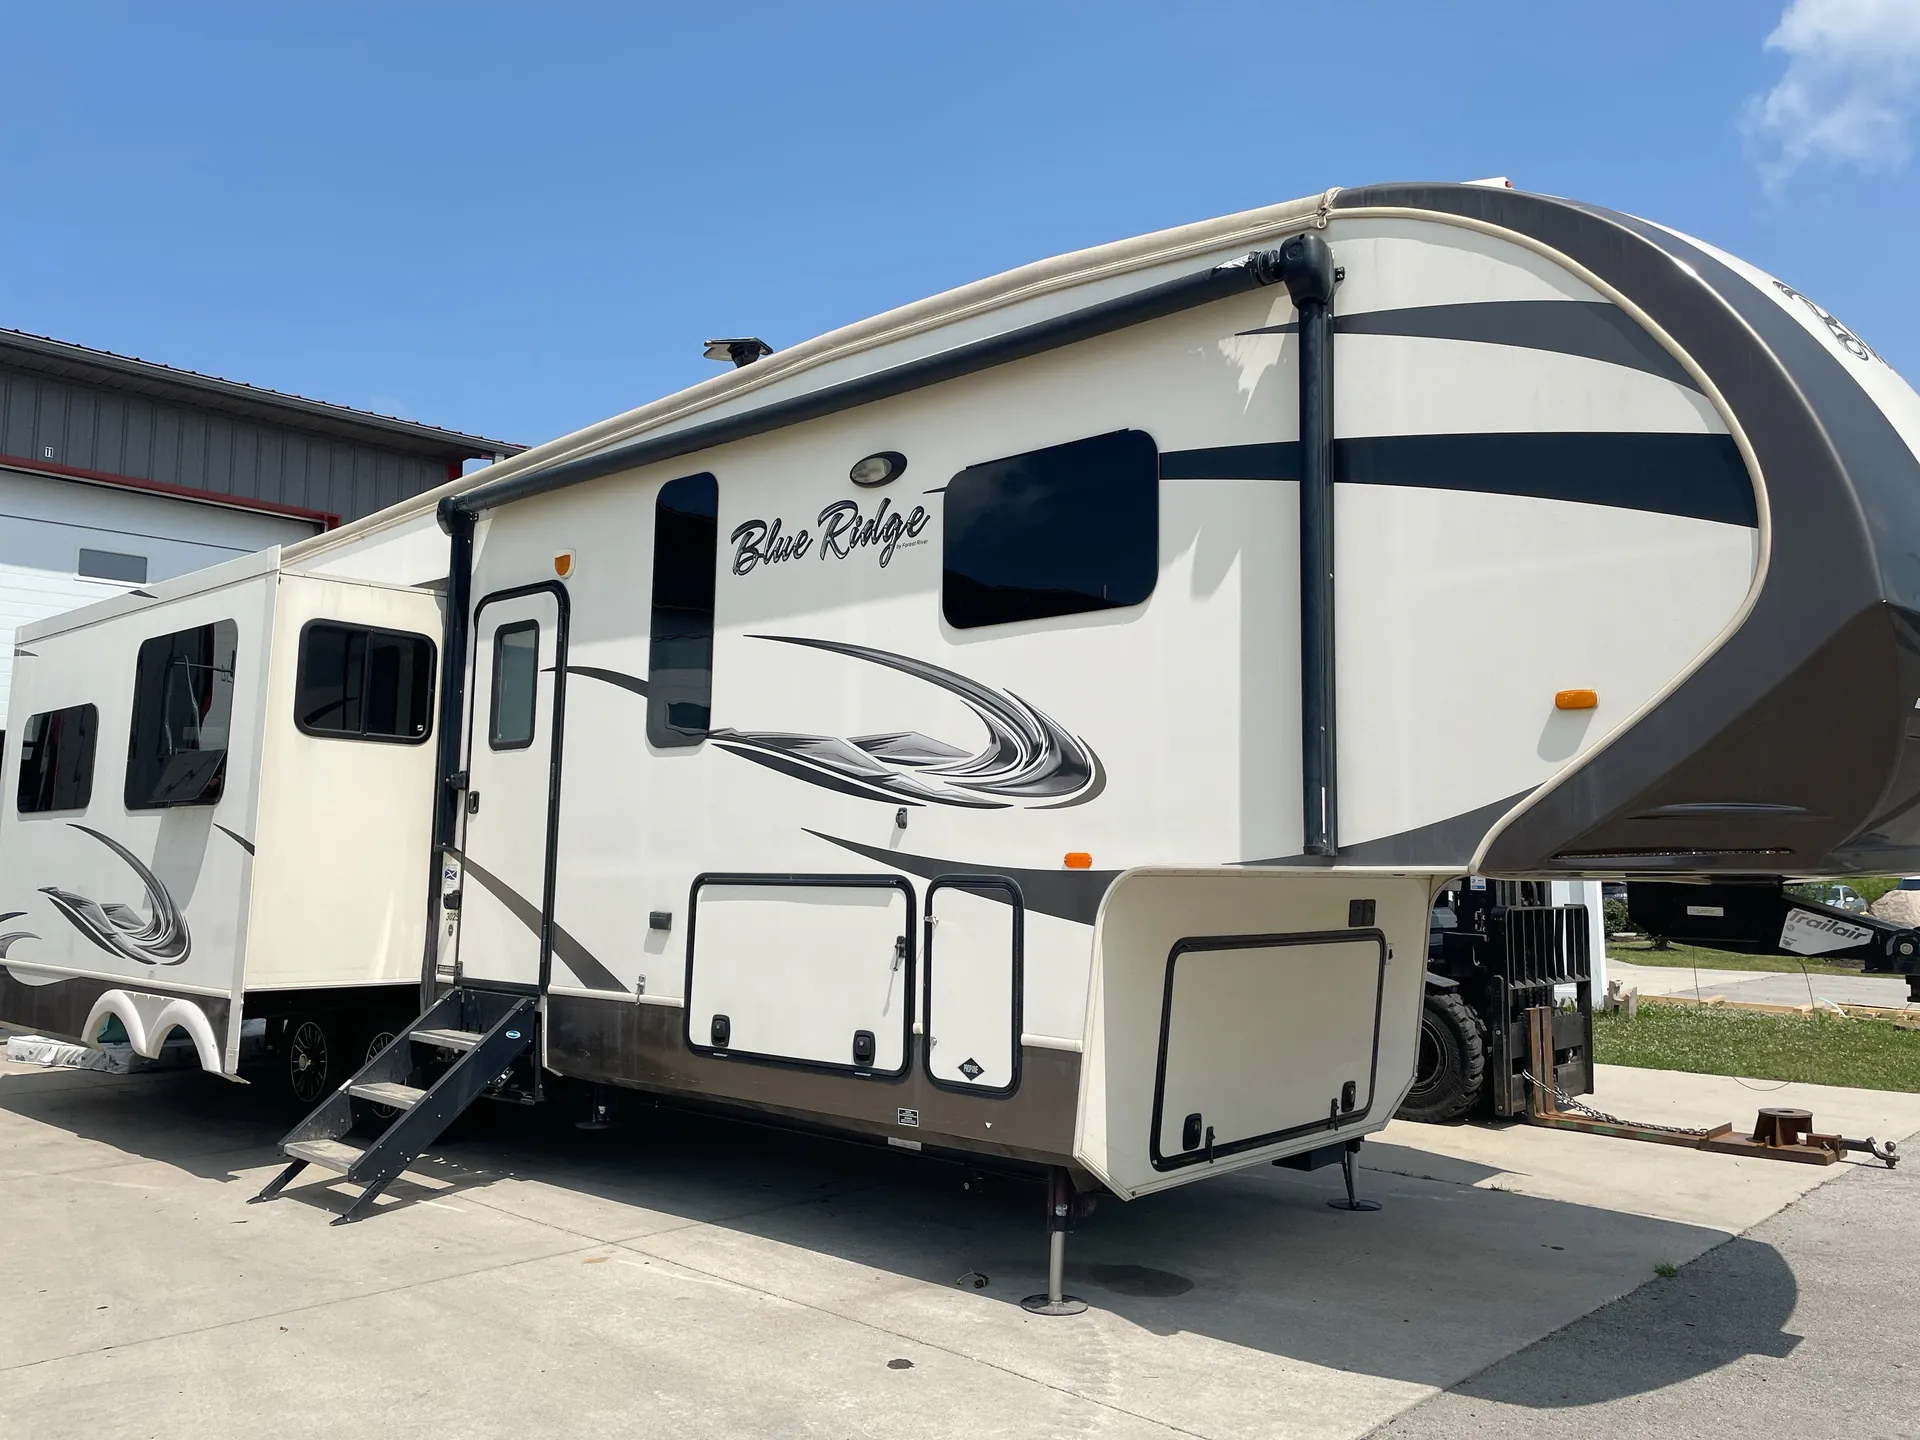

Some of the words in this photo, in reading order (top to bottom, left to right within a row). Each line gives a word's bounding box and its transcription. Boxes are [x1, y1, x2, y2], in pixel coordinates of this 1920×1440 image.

[731, 518, 813, 576] Blue
[818, 497, 931, 568] Ridge
[1788, 909, 1868, 940] Trailair
